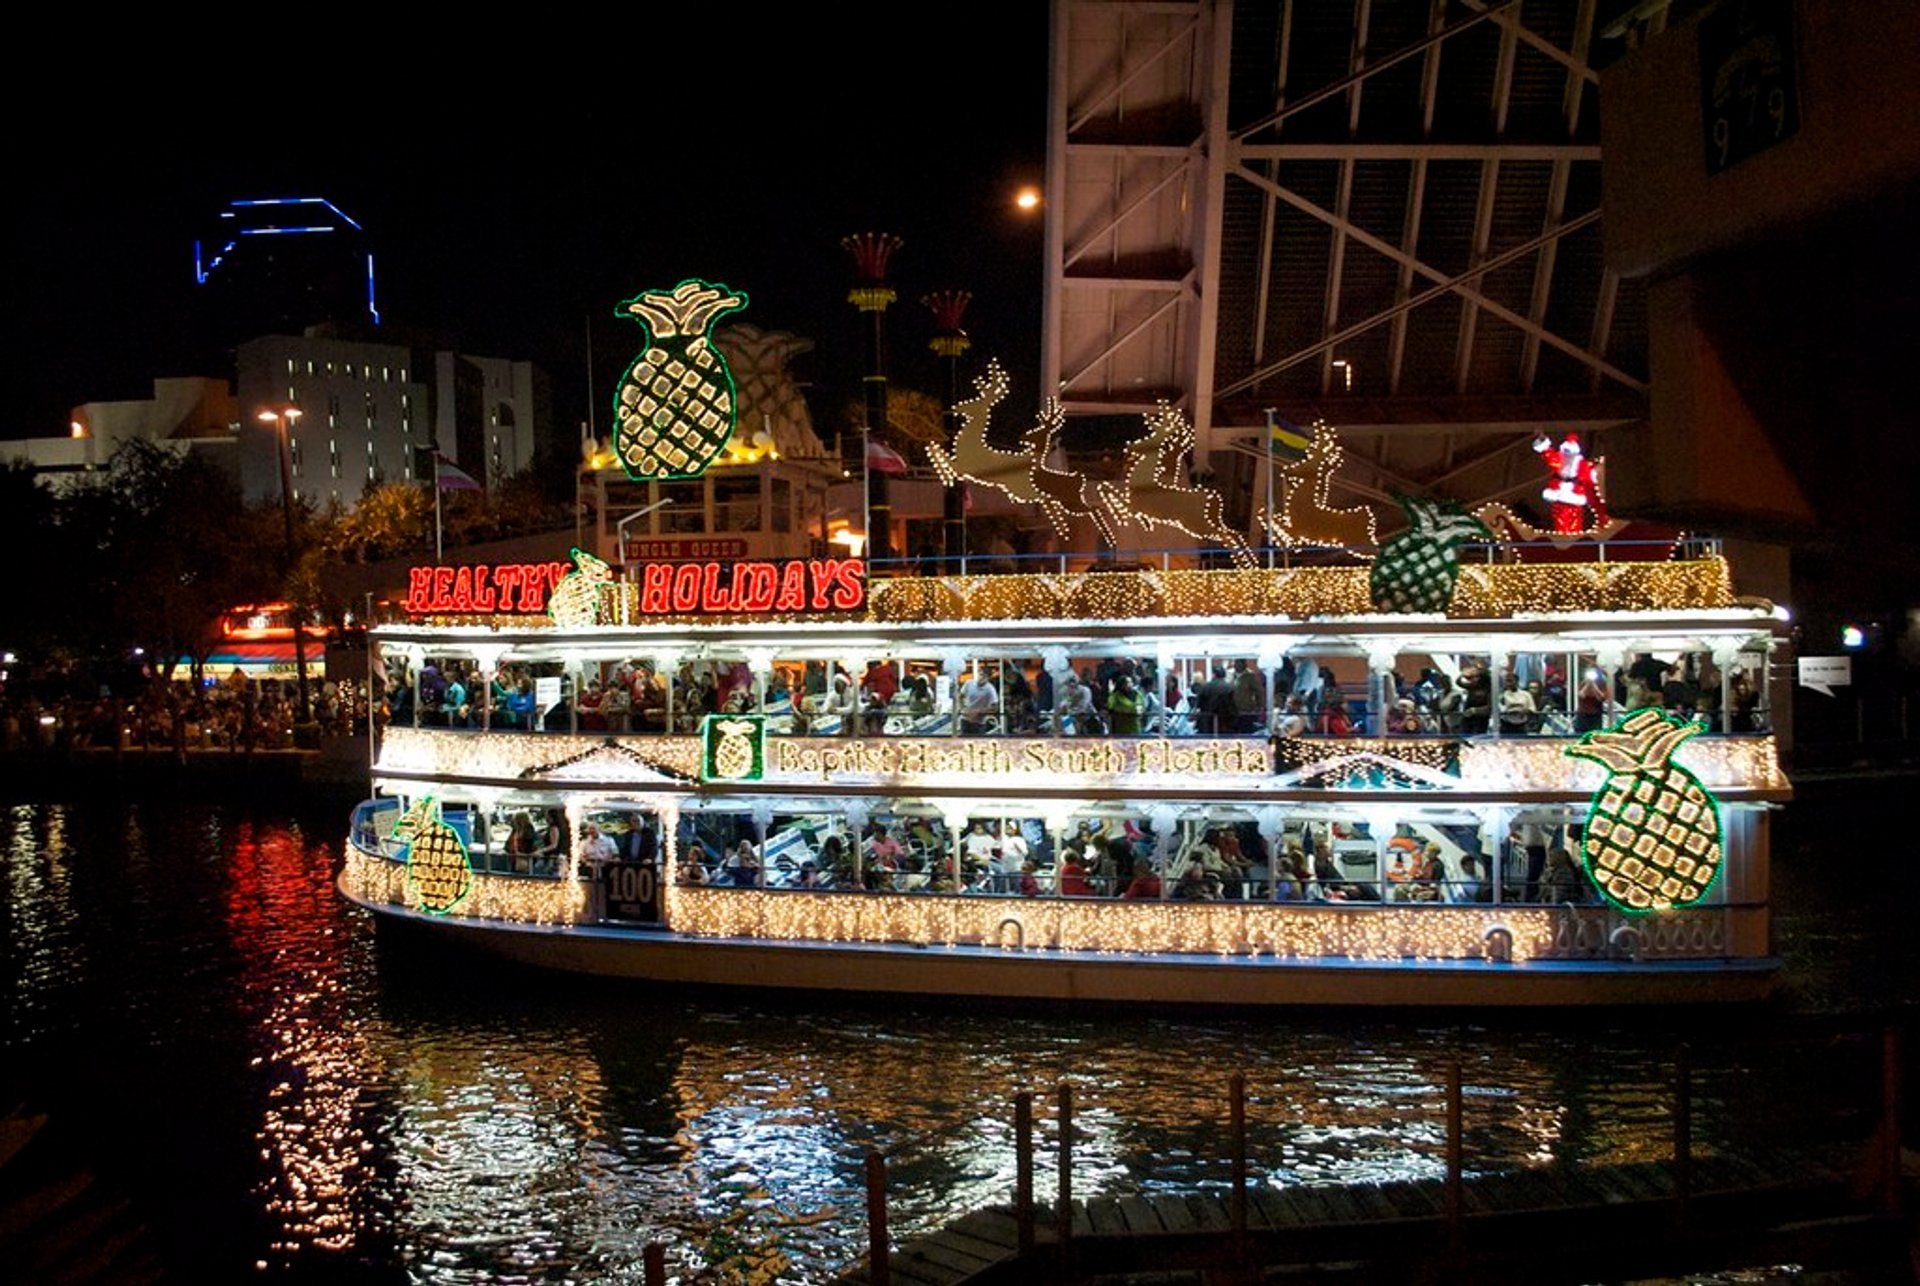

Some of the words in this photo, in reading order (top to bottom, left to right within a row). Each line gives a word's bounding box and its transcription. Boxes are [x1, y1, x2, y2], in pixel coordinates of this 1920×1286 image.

[691, 541, 741, 557] QUEEN
[641, 559, 863, 613] HOLIDAYS
[779, 740, 895, 781] Baptist
[898, 740, 1012, 774] Health
[1024, 740, 1126, 774] South
[1137, 740, 1268, 775] Florida
[608, 866, 654, 903] 100
